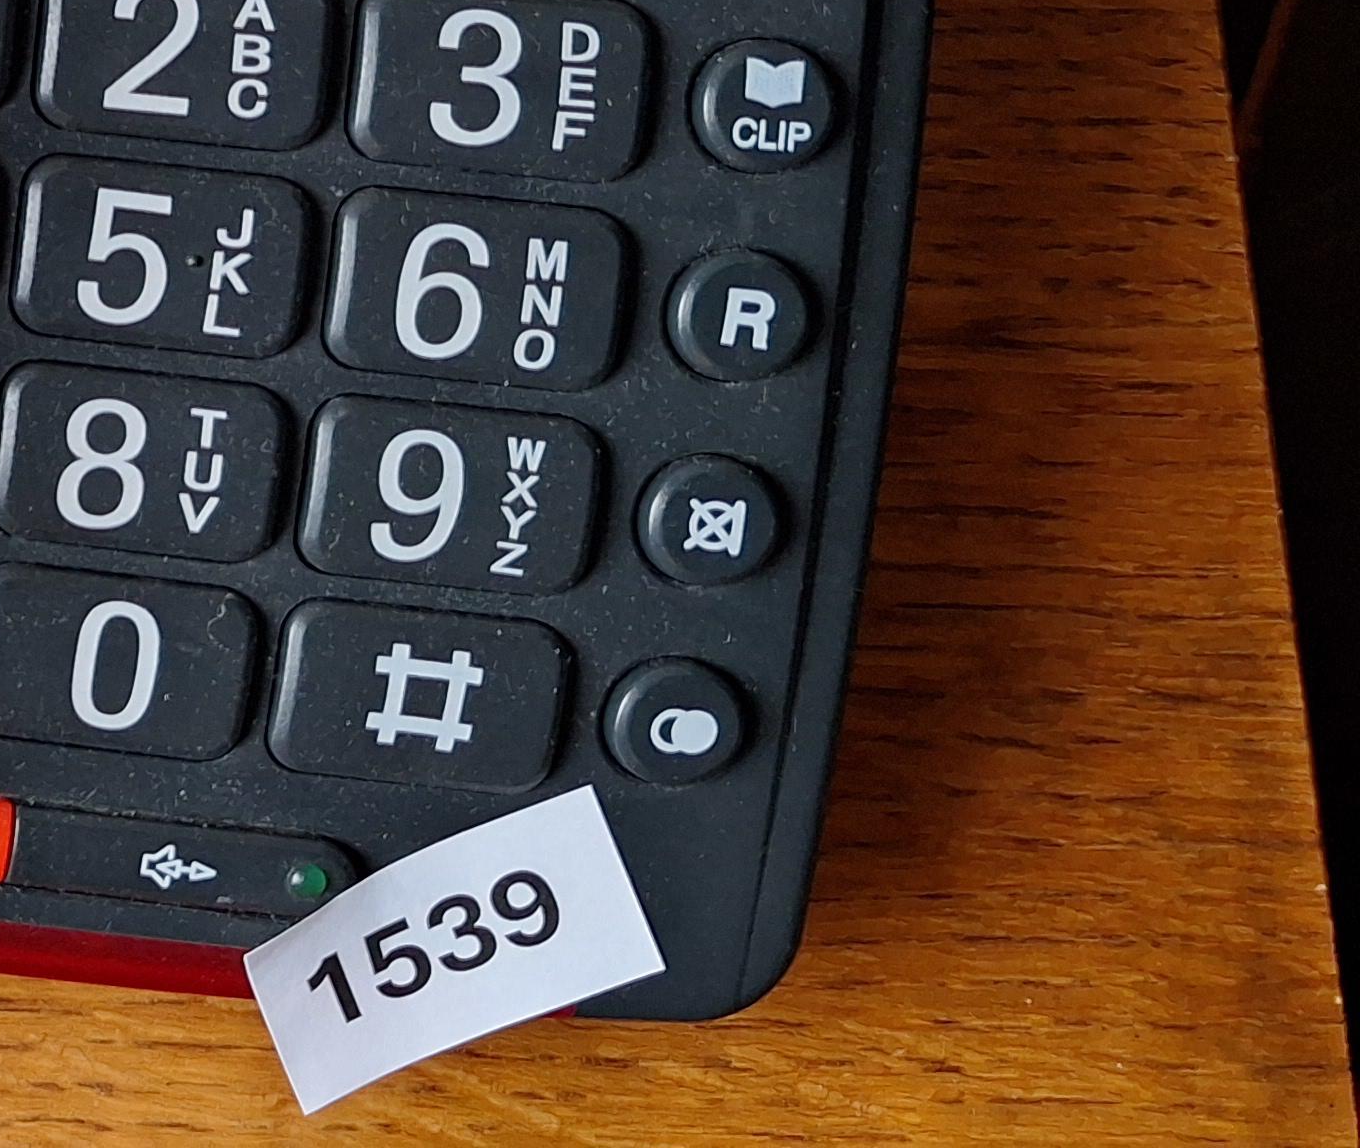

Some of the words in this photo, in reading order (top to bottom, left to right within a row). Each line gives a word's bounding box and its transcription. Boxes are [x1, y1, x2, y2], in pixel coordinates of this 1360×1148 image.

[428, 9, 523, 147] 3
[551, 21, 602, 151] DEF
[732, 117, 813, 153] CLIP
[76, 187, 173, 326] 5
[202, 207, 255, 338] JKL
[394, 223, 491, 360] 6
[513, 238, 569, 371] MNO
[719, 288, 776, 351] R
[56, 398, 147, 530] 8
[179, 407, 228, 534] TUV
[370, 429, 465, 563] 9
[489, 436, 546, 577] WXYZ
[71, 600, 161, 731] 0
[307, 869, 561, 1024] 1539
